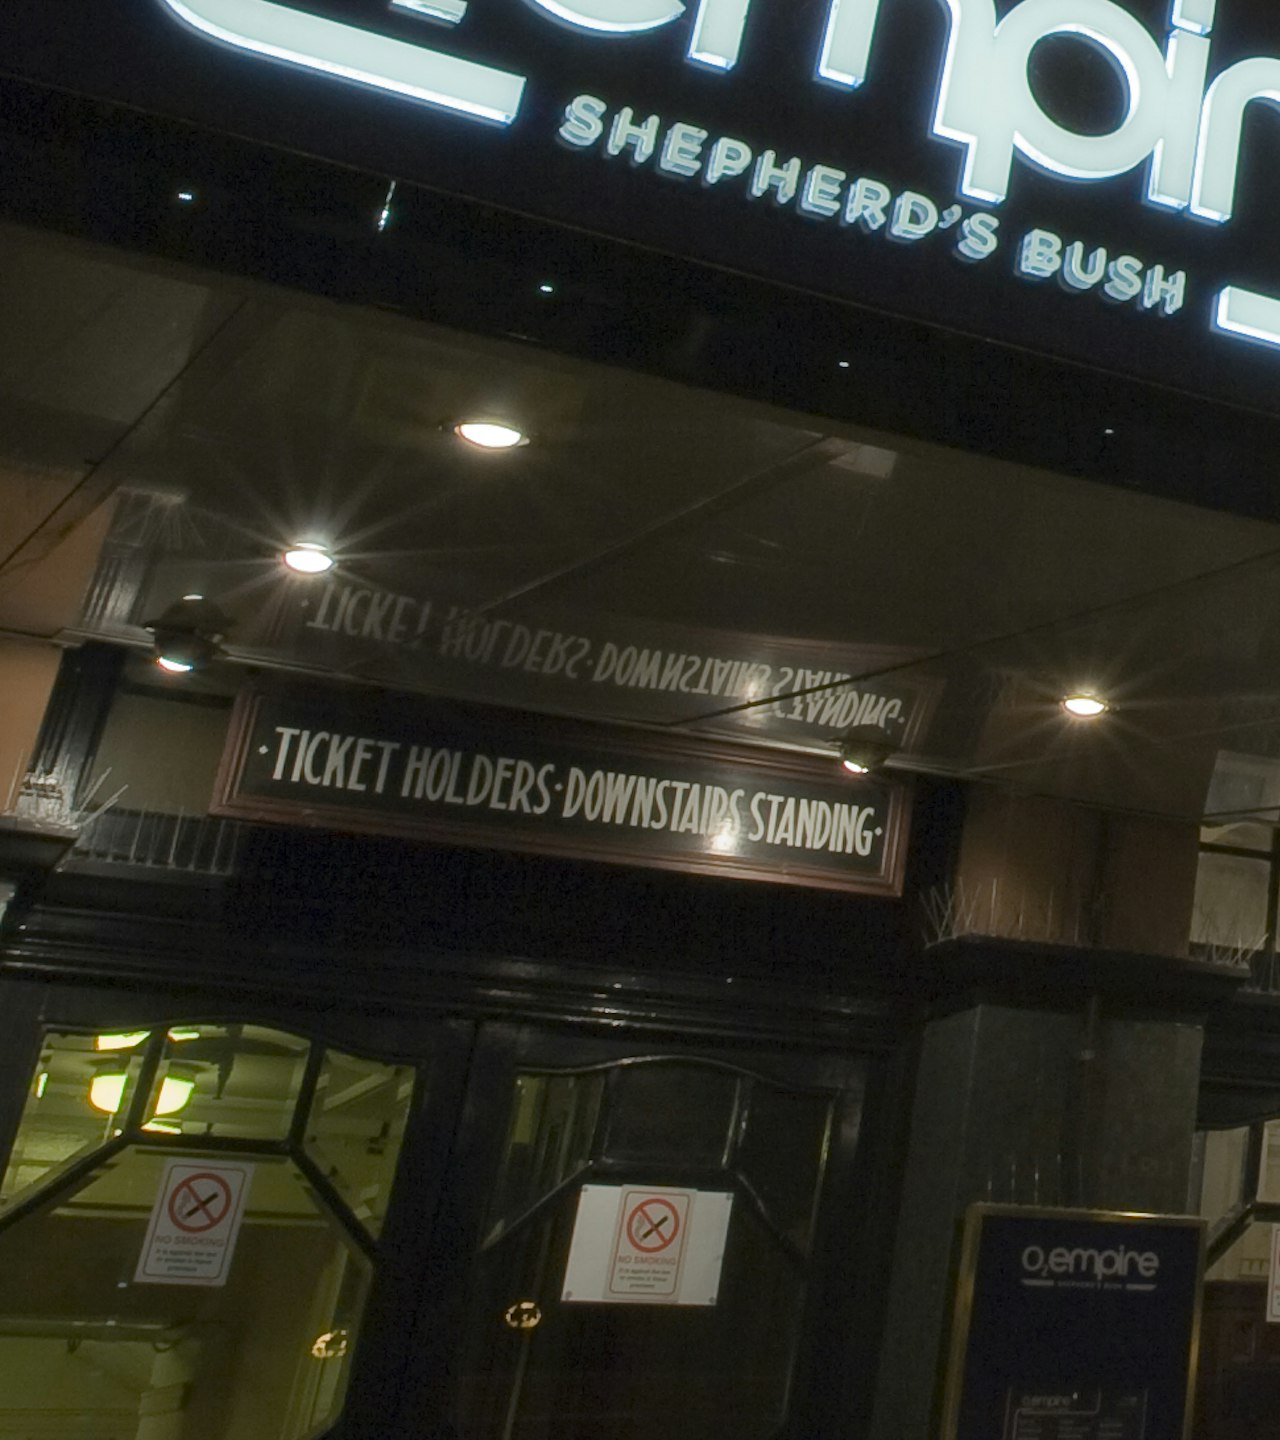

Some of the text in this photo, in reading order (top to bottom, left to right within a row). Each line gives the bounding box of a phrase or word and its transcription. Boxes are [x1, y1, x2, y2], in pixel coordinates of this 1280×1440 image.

[559, 94, 1187, 316] SHEPHERD'S BUSH
[272, 726, 875, 857] TICKET HOLDERS DOWNSTAIRS STANDING
[1048, 1245, 1159, 1280] empire
